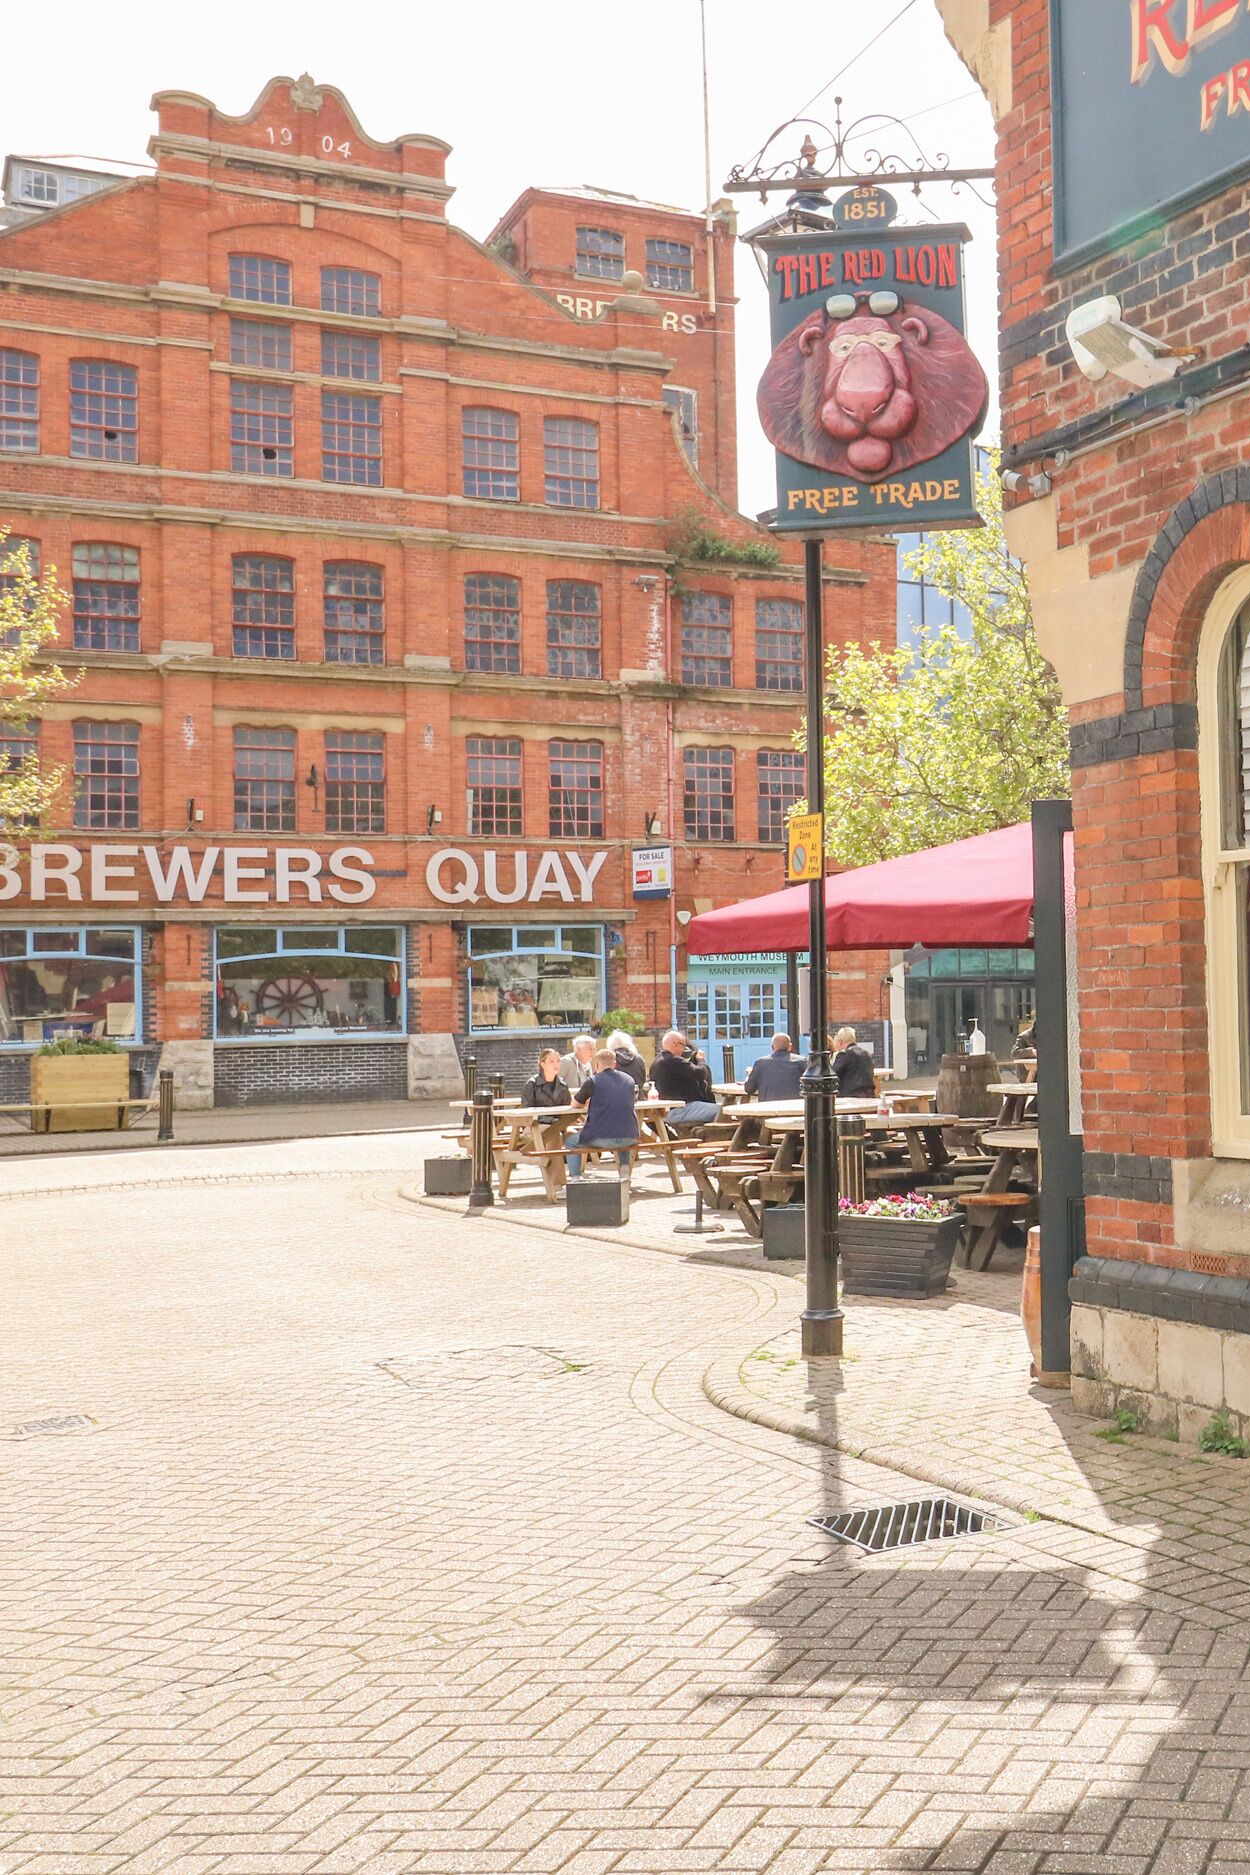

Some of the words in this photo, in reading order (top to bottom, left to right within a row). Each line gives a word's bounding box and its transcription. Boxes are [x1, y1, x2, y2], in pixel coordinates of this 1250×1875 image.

[853, 187, 879, 199] EST.
[843, 200, 886, 221] 1851
[776, 251, 835, 299] THE
[844, 248, 886, 285] RED
[896, 243, 957, 289] LION
[787, 485, 859, 514] FREE
[869, 479, 961, 508] TRADE
[792, 819, 819, 829] Restricted
[799, 831, 811, 840] Zone
[639, 853, 651, 861] FOR
[651, 851, 665, 860] SALE
[426, 847, 609, 905] QUAY
[698, 951, 758, 962] WEYMOUTH
[760, 951, 804, 961] MUSEM
[709, 967, 731, 976] MAIN
[732, 966, 778, 976] ENTRANCE
